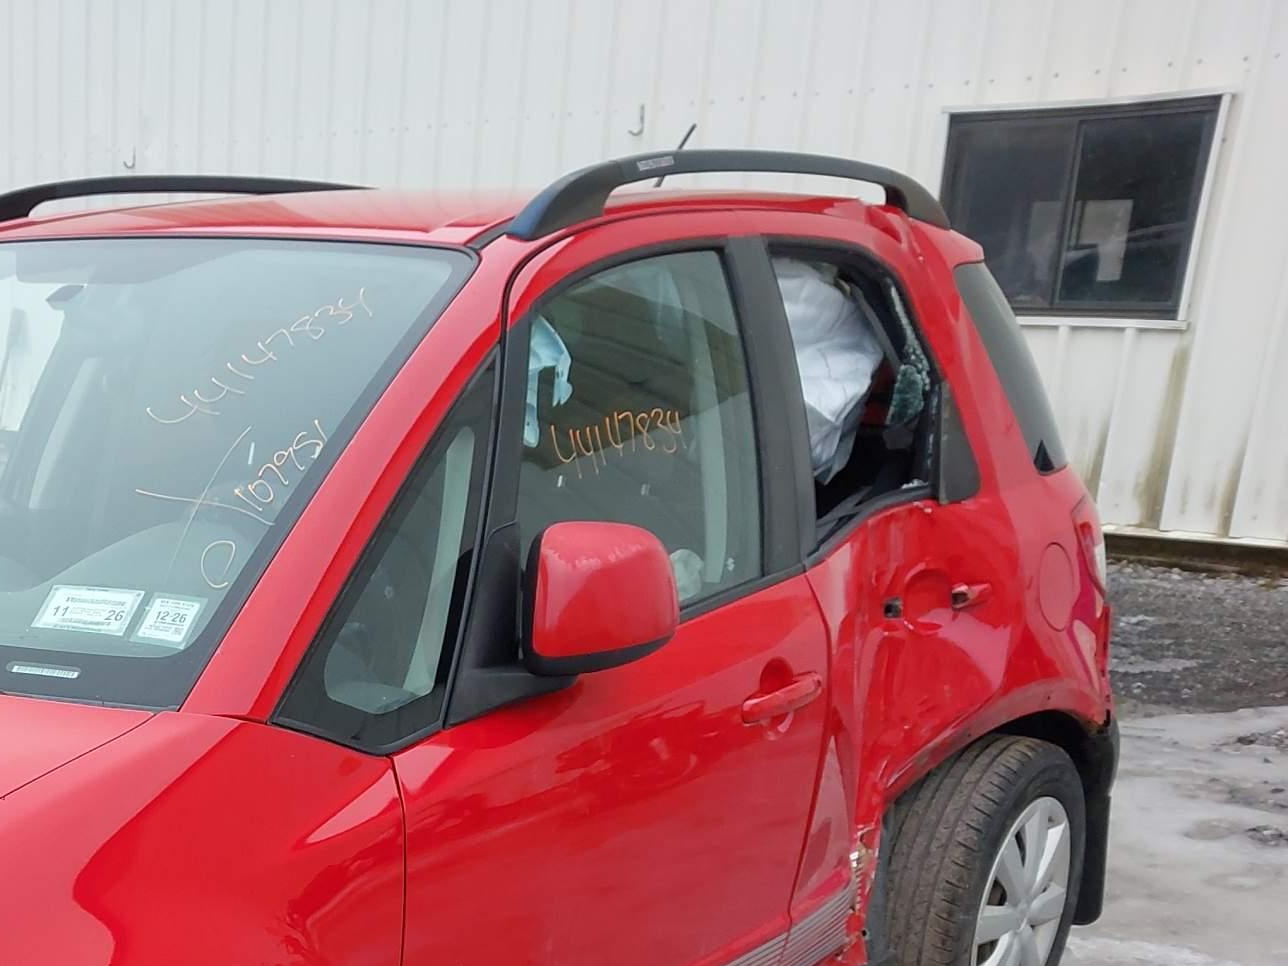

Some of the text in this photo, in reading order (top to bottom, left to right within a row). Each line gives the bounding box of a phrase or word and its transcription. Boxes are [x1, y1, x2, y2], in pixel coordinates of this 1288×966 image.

[146, 287, 373, 424] 44147834
[550, 407, 687, 479] 44147834
[53, 606, 69, 617] 11
[104, 610, 125, 622] 26
